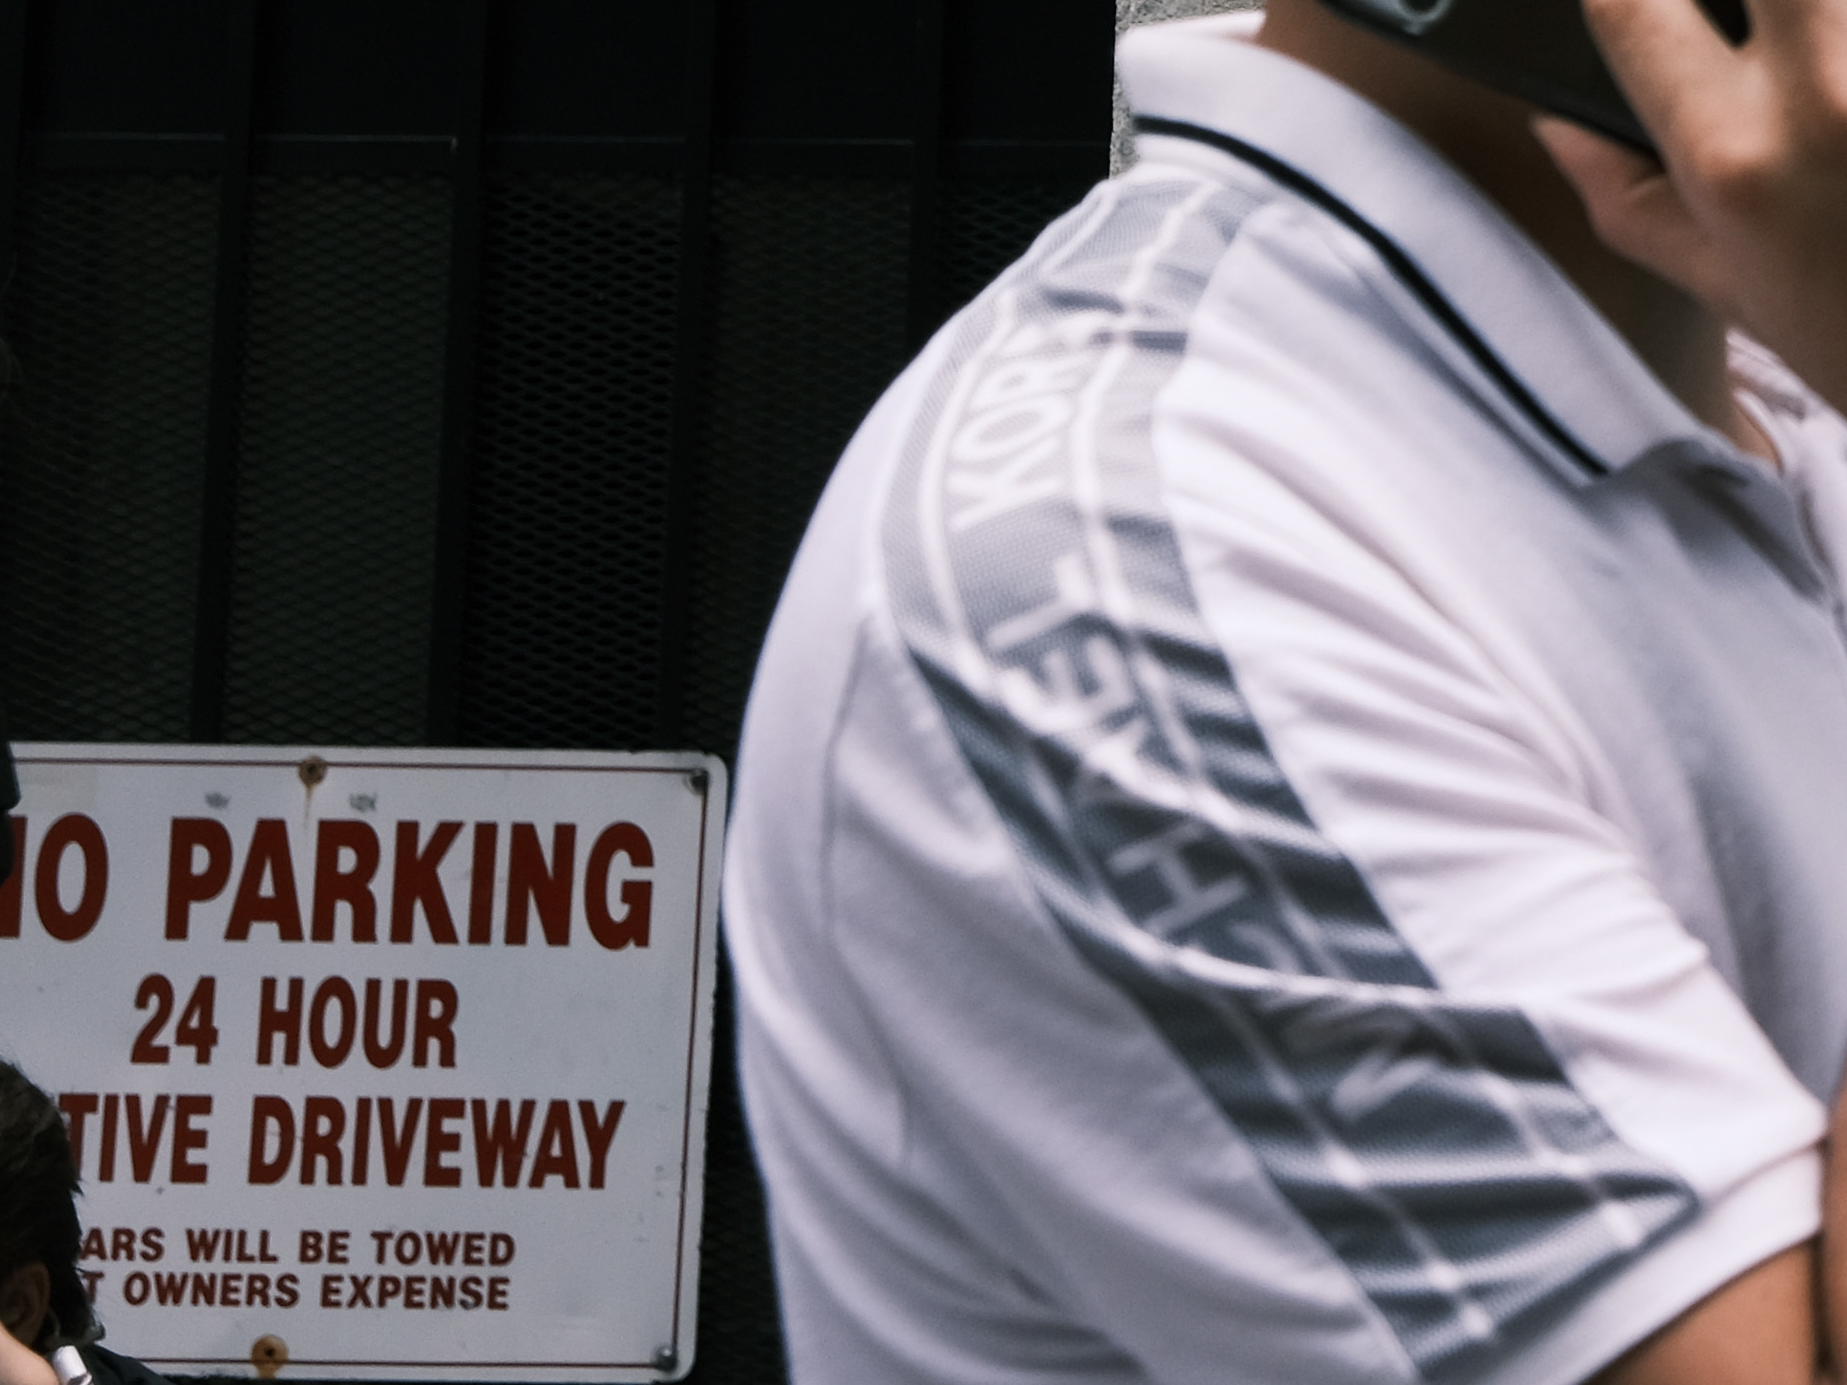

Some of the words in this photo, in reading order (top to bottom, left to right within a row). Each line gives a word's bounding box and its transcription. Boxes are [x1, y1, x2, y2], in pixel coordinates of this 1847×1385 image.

[164, 818, 654, 952] PARKING
[130, 974, 218, 1066] 24
[256, 976, 457, 1070] HOUR
[58, 1094, 213, 1185] TIVE
[247, 1096, 624, 1190] DRIVEWAY
[81, 1228, 164, 1262] ARS
[185, 1229, 277, 1264] WILL
[298, 1231, 350, 1265] BE
[371, 1232, 514, 1267] TOWED
[82, 1271, 105, 1305] T
[123, 1272, 298, 1308] OWNERS
[320, 1276, 509, 1311] EXPENSE
